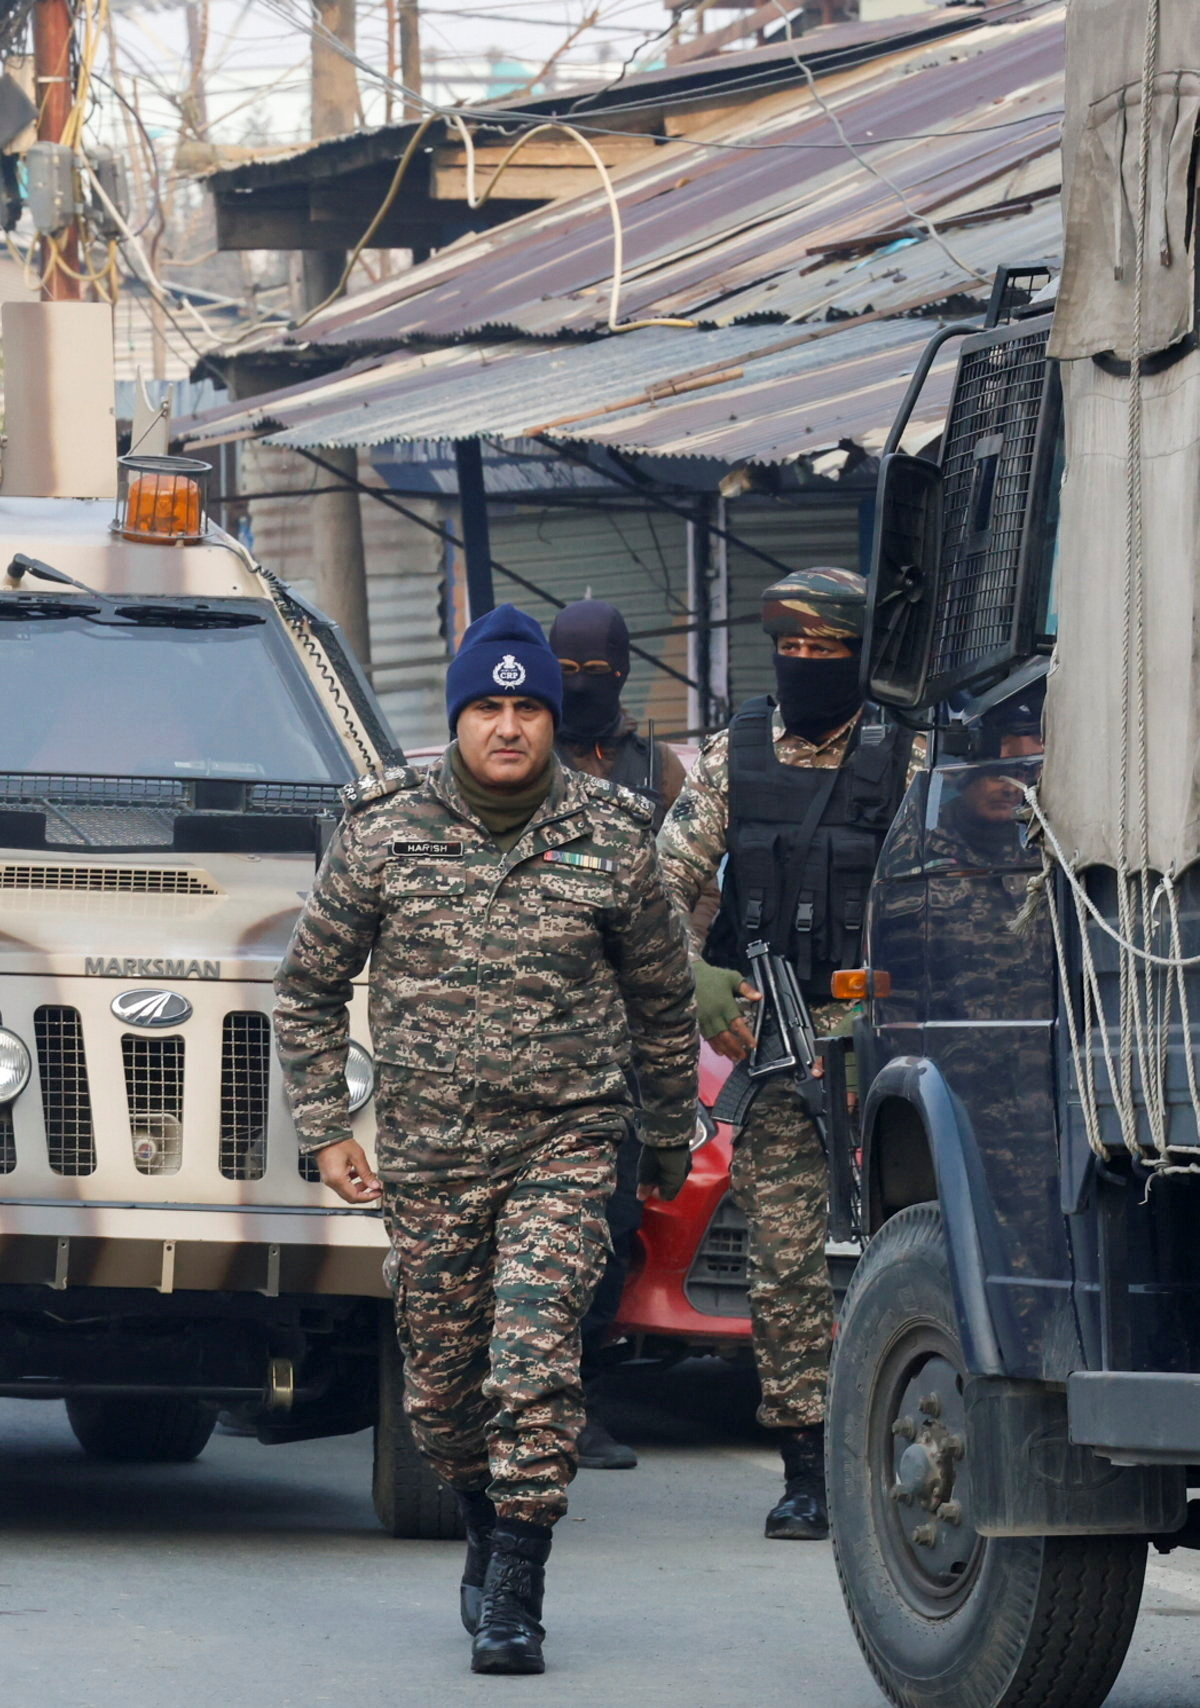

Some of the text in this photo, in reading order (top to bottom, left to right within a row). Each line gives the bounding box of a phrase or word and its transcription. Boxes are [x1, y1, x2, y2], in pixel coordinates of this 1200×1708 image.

[500, 672, 518, 680] CRP
[343, 783, 358, 801] CRP
[407, 844, 448, 853] HARISH
[84, 957, 221, 979] MARKSMAN
